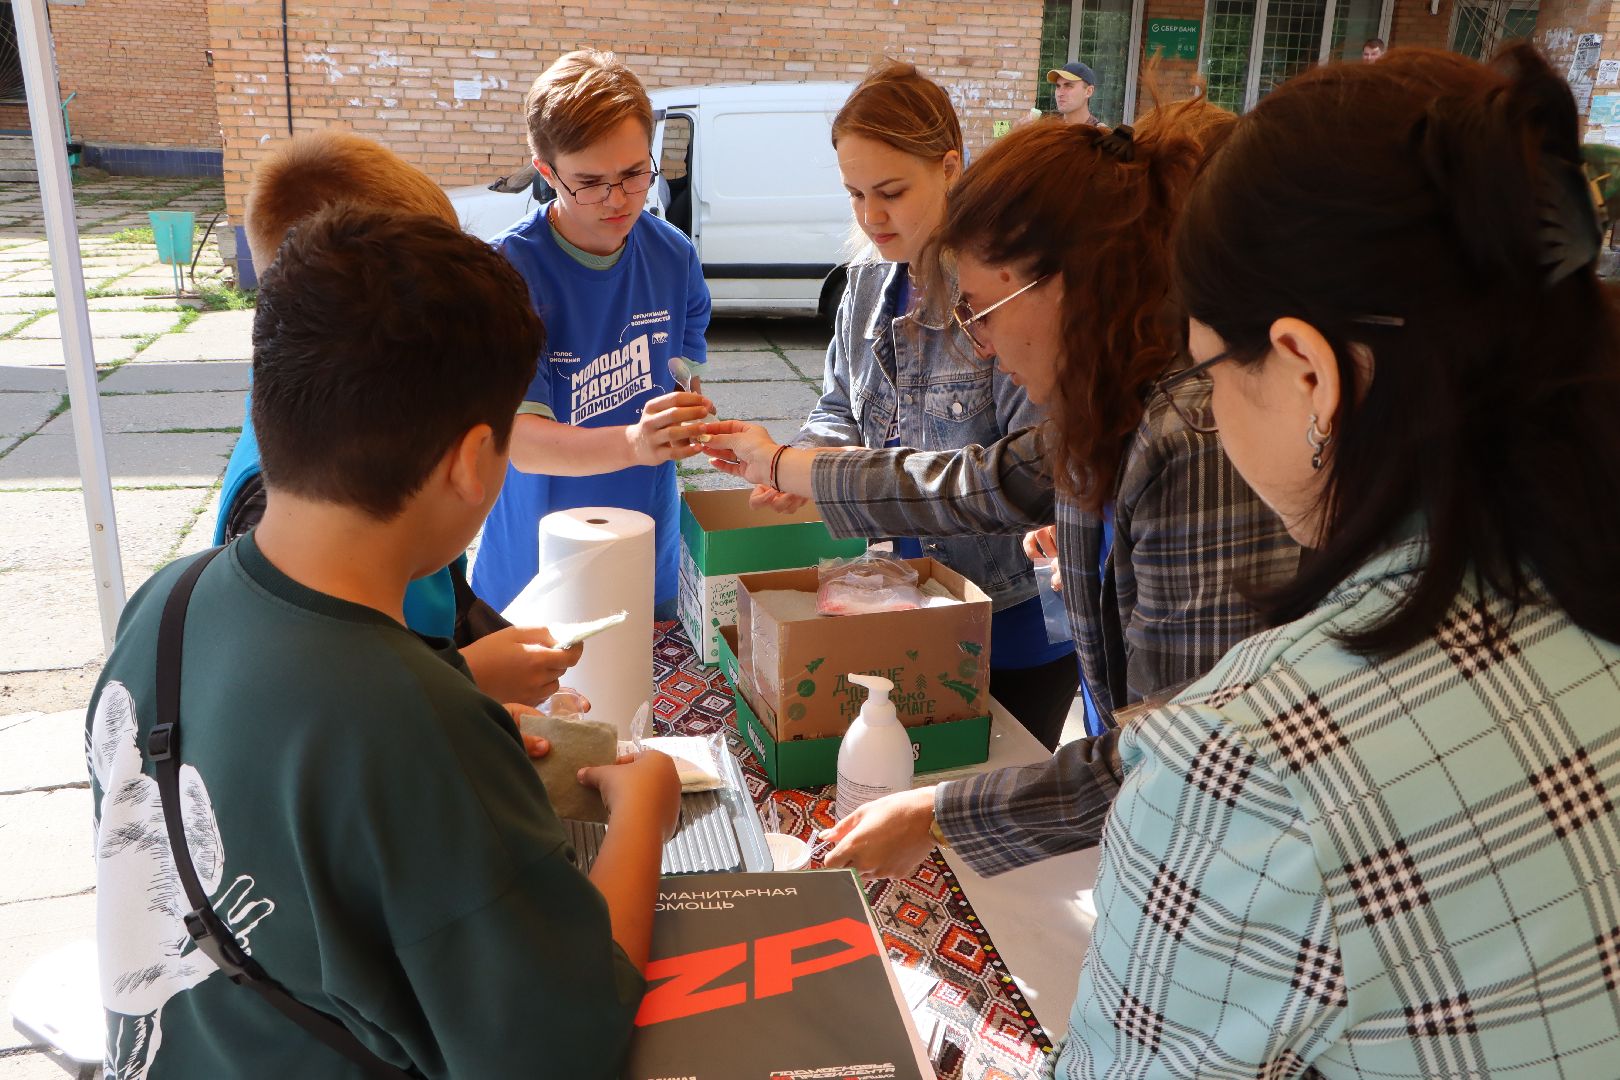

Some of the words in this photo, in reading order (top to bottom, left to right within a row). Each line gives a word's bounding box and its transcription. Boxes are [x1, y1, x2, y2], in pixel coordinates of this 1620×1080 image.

[571, 333, 651, 391] МОЛОДАЯ
[574, 376, 648, 424] ПОДМОСКОВЬЕ
[654, 900, 735, 912] ОМОЩЬ
[656, 887, 798, 901] МАНИТАРНАЯ
